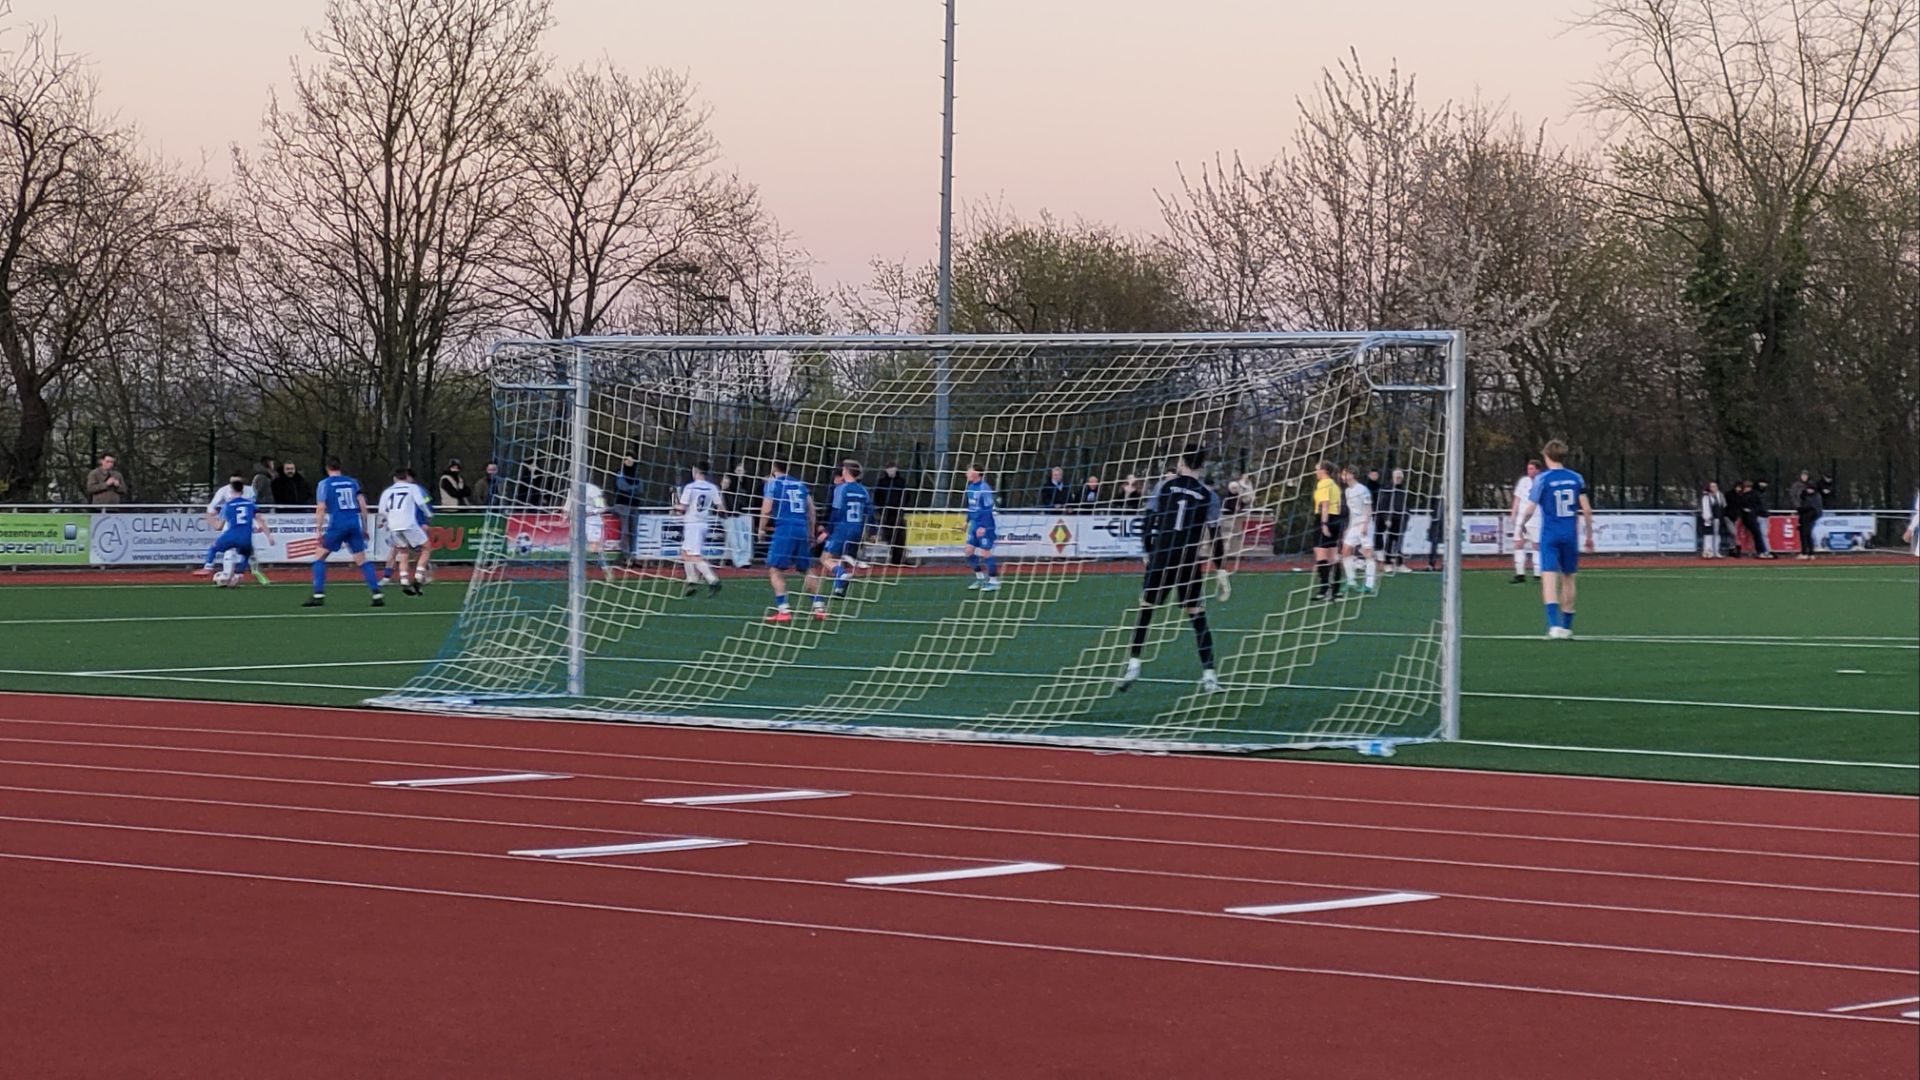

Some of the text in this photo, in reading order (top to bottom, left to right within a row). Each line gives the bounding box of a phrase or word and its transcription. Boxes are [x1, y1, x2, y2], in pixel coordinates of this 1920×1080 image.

[389, 492, 408, 509] 17
[1553, 489, 1575, 517] 12
[236, 506, 248, 524] 2
[1173, 500, 1186, 531] 1
[132, 517, 182, 533] CLEAN
